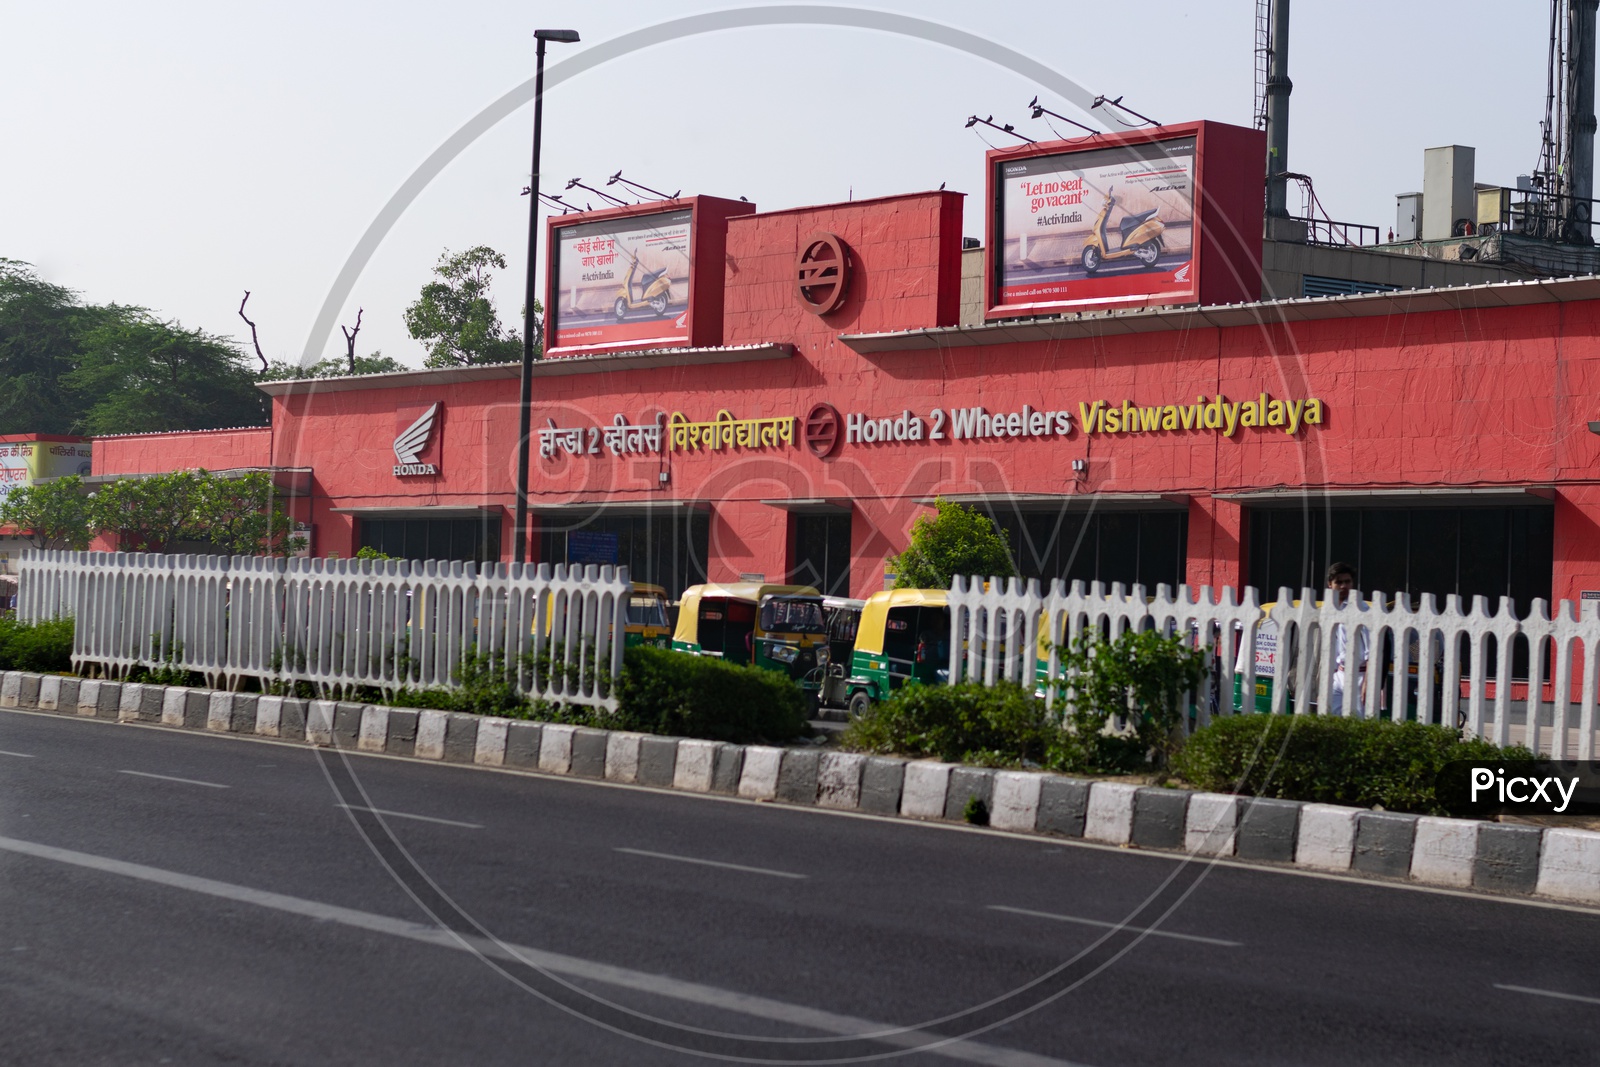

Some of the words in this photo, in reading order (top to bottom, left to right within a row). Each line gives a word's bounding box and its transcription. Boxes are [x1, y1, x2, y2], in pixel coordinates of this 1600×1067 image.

[1044, 181, 1059, 194] no
[1060, 177, 1083, 192] seat
[1031, 197, 1045, 213] go
[1037, 211, 1082, 226] #ActivIndia
[592, 237, 606, 251] सीट
[582, 256, 595, 268] जाए
[846, 409, 923, 443] Honda
[929, 408, 944, 440] 2
[951, 404, 1072, 438] Wheelers
[1079, 392, 1323, 438] Vishwavidyalaya
[538, 417, 585, 457] होन्डा
[587, 427, 600, 453] 2
[603, 412, 664, 456] व्हीलर्स
[668, 409, 797, 451] विश्वविद्यालय
[11, 444, 19, 458] की
[21, 444, 33, 457] मित्र
[393, 464, 435, 476] HONDA
